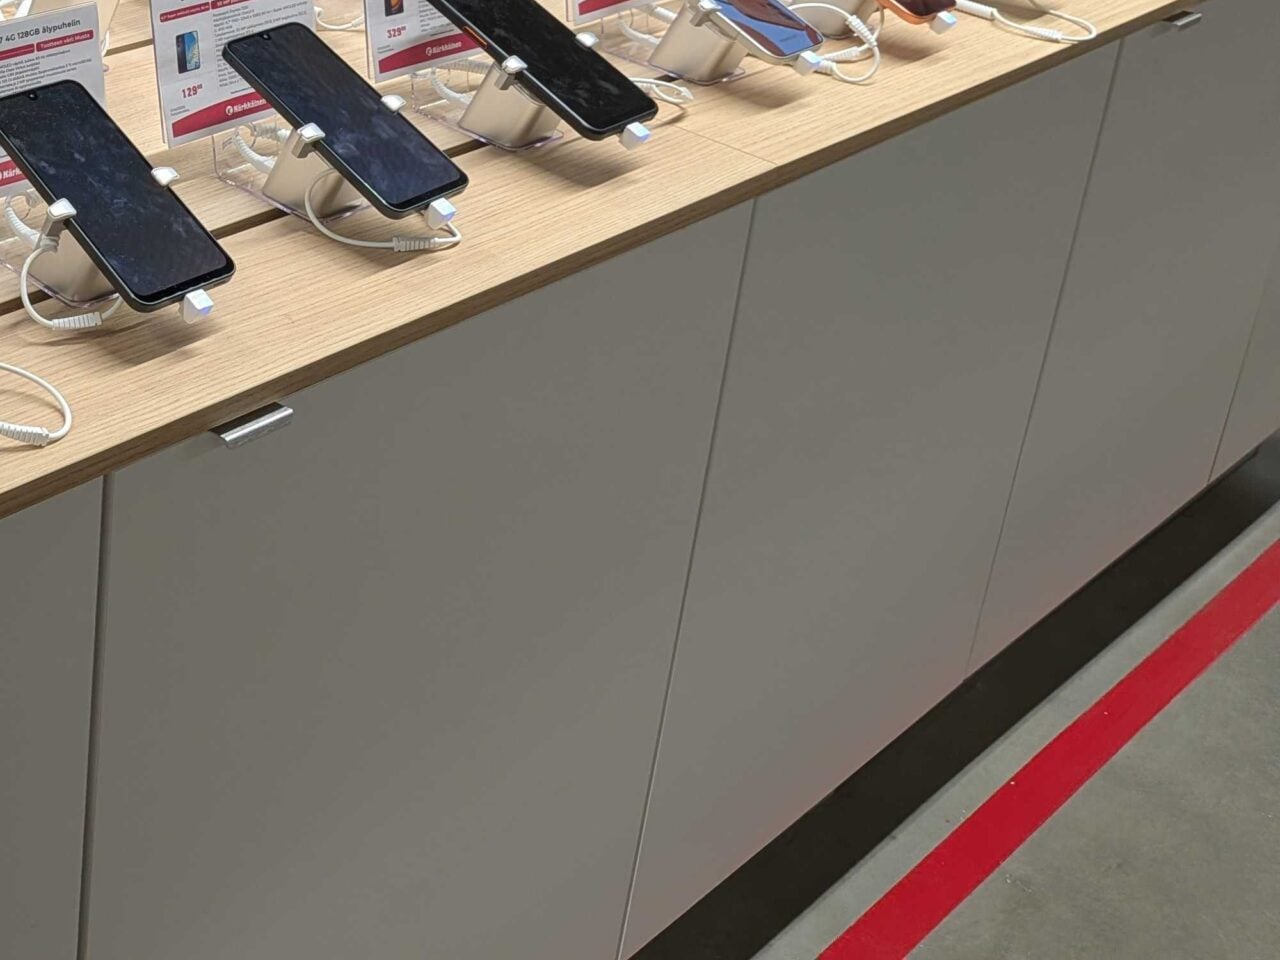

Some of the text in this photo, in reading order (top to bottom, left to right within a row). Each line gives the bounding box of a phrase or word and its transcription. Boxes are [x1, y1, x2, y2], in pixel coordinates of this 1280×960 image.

[4, 33, 15, 42] 4G
[16, 27, 40, 39] 128GB
[41, 18, 80, 34] älypuhelin
